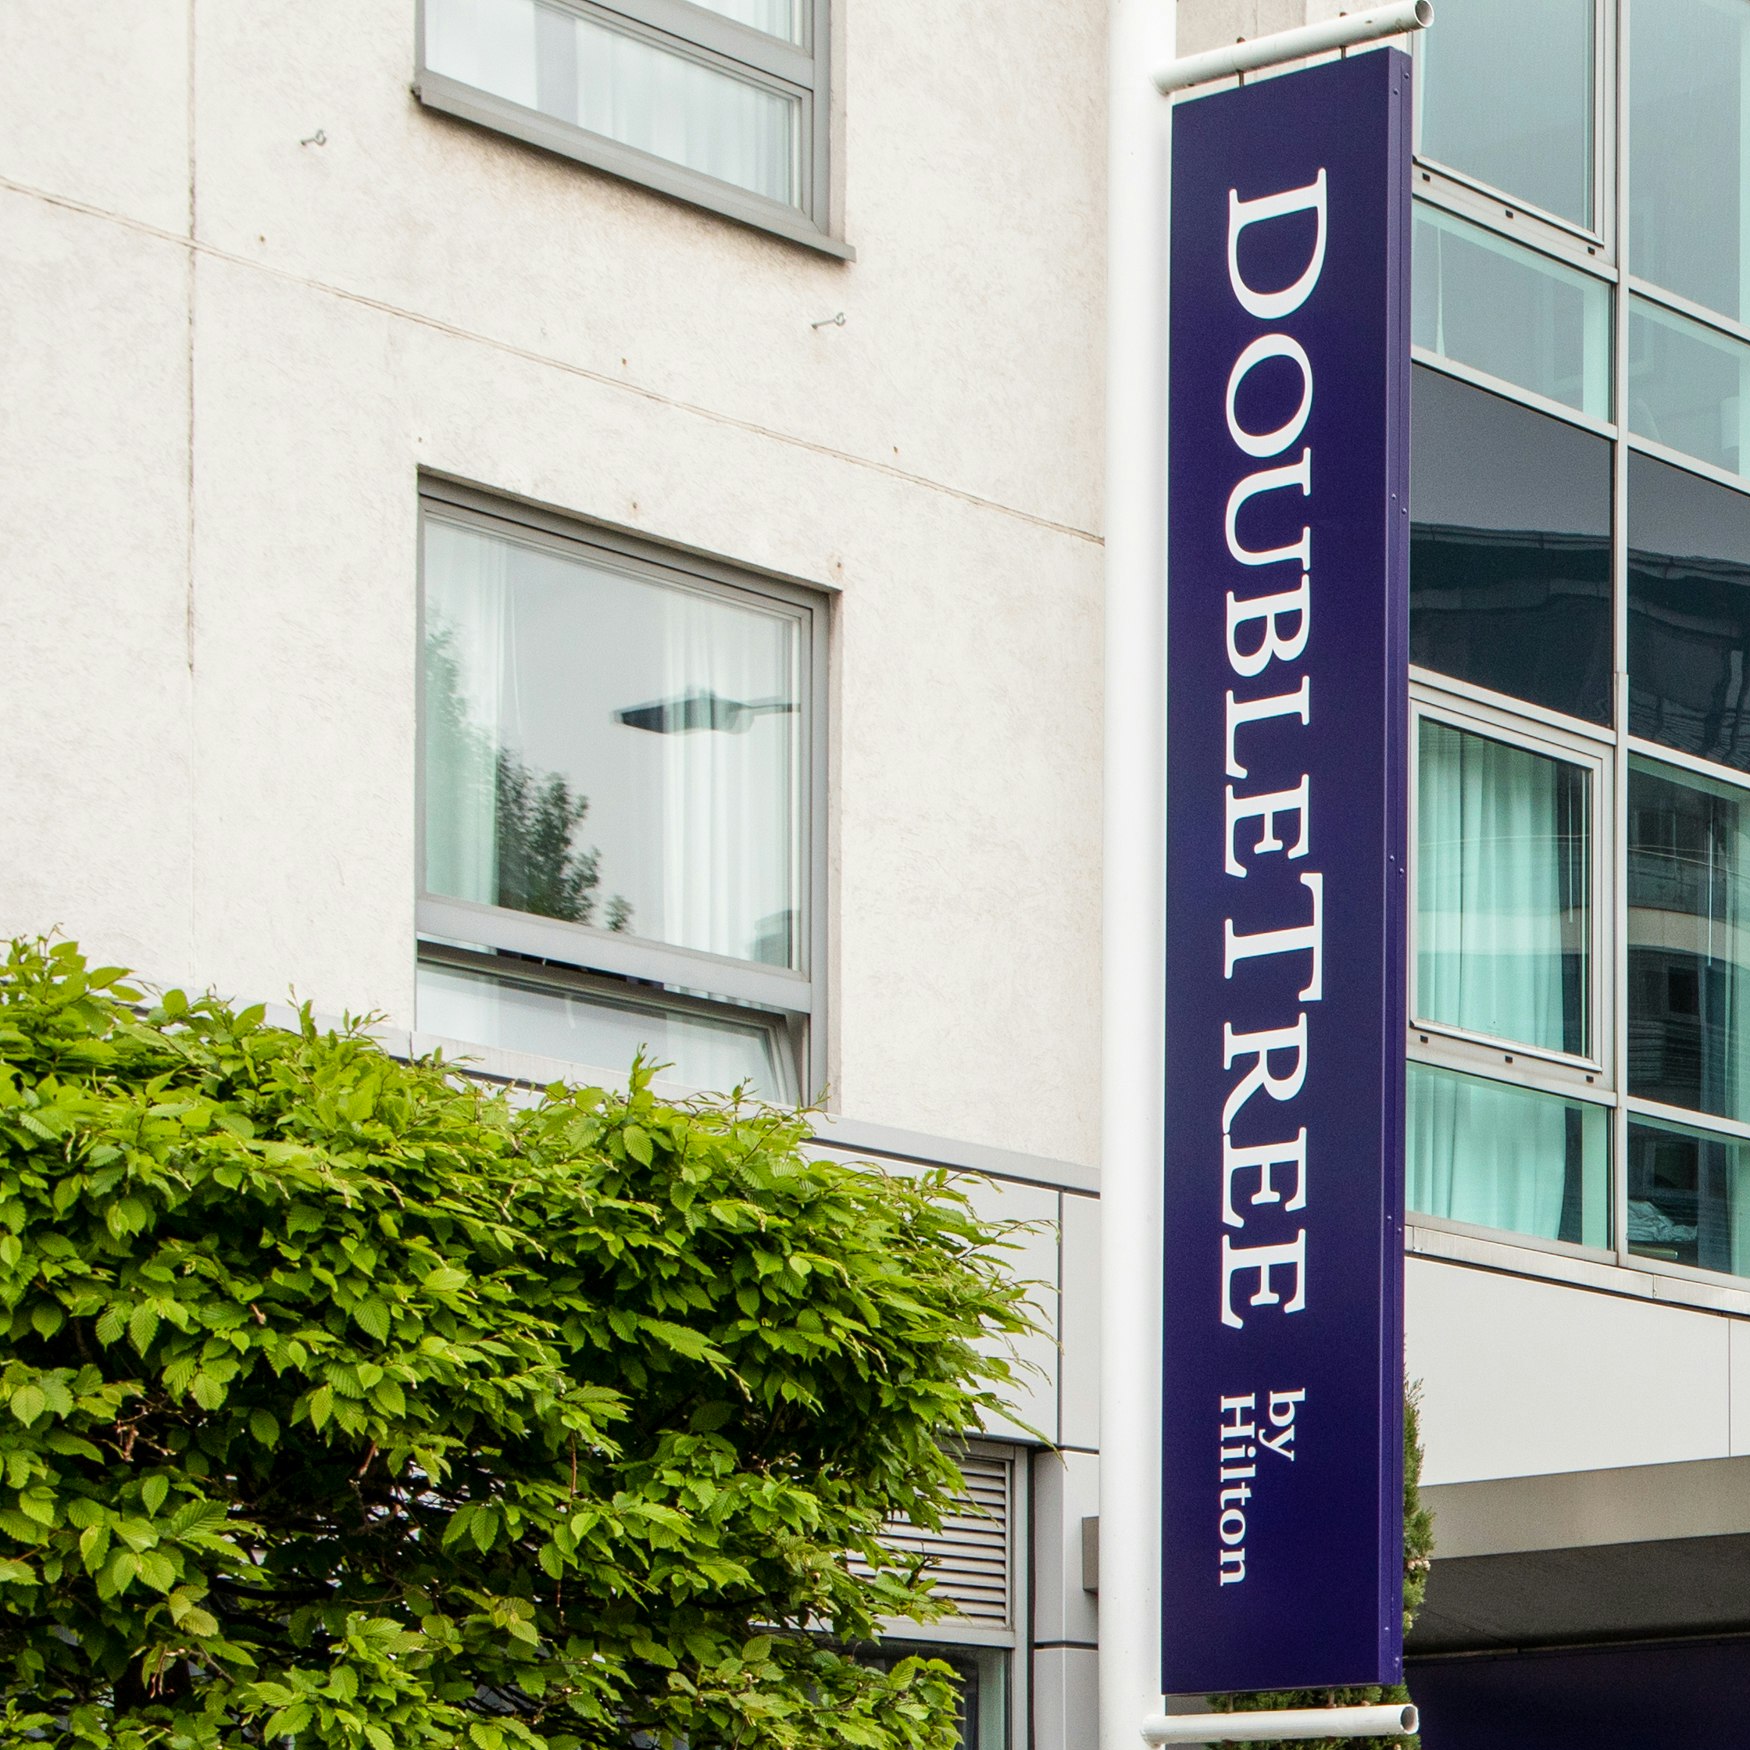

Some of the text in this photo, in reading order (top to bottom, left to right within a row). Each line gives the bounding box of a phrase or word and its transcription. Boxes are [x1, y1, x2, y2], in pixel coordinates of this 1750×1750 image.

[1221, 167, 1327, 1329] DOUBLETREE
[1219, 1392, 1257, 1587] Hilton
[1258, 1387, 1306, 1462] by
